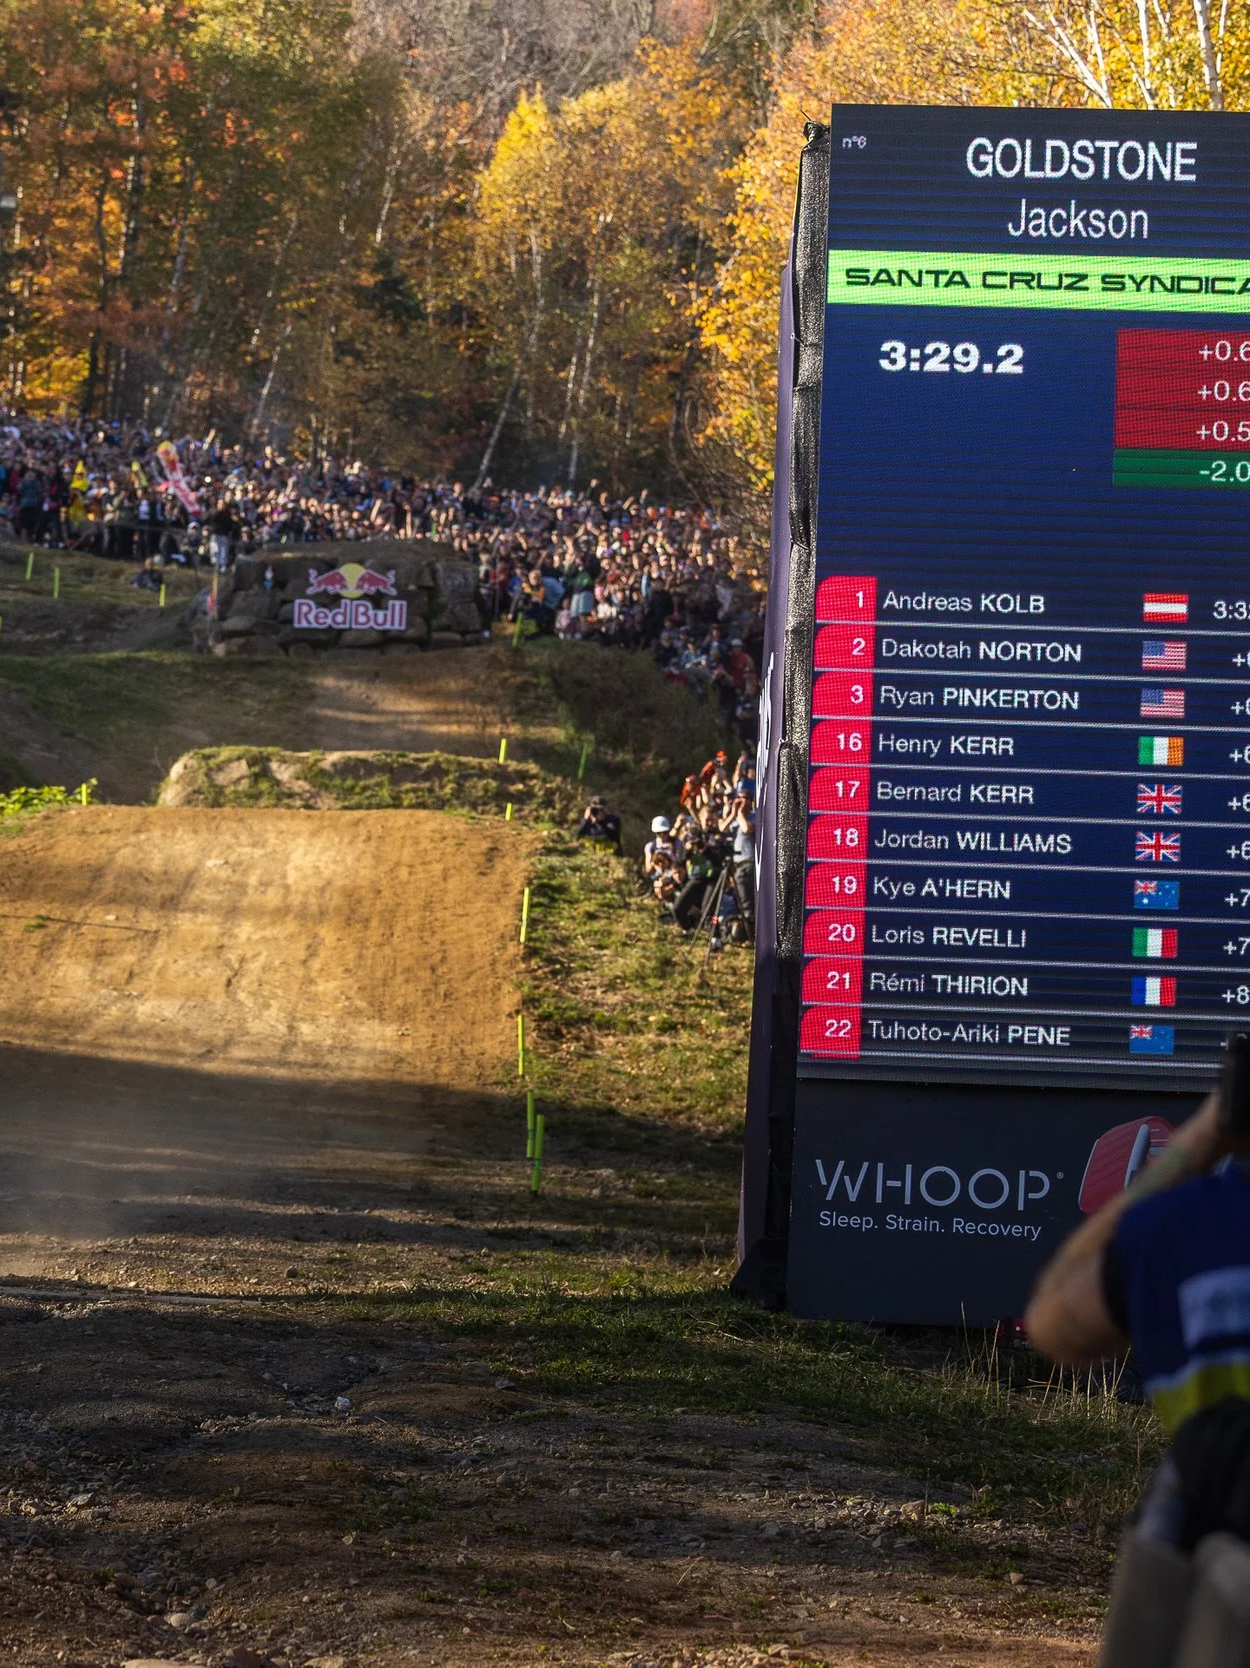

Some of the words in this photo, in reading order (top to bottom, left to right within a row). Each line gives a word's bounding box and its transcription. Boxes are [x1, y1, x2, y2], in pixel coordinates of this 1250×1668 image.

[966, 137, 1198, 182] GOLDSTONE
[1007, 199, 1149, 239] Jackson
[845, 267, 971, 288] SANTA
[981, 272, 1090, 292] CRUZ
[878, 340, 1024, 374] 3:29.2
[855, 592, 865, 608] 1
[882, 591, 973, 611] Andreas
[980, 593, 1046, 613] KOLB
[1213, 600, 1250, 619] 3:3
[852, 639, 866, 657] 2
[881, 639, 972, 659] Dakotah
[979, 641, 1082, 663] NORTON
[850, 685, 864, 704] 3
[879, 686, 934, 708] Ryan
[943, 687, 1079, 711] PINKERTON
[837, 732, 863, 752] 16
[878, 733, 942, 757] Henry
[950, 736, 1014, 756] KERR
[835, 780, 861, 799] 17
[876, 781, 962, 802] Bernard
[969, 784, 1034, 804] KERR
[833, 828, 859, 847] 18
[874, 829, 949, 850] Jordan
[957, 832, 1072, 854] WILLIAMS
[831, 876, 858, 894] 19
[873, 877, 916, 899] Kye
[921, 879, 1011, 900] A'HERN
[828, 924, 856, 942] 20
[871, 925, 926, 946] Loris
[932, 927, 1027, 948] REVELLI
[826, 971, 851, 990] 21
[869, 972, 925, 993] Rémi
[931, 974, 1029, 996] THIRION
[824, 1019, 852, 1038] 22
[867, 1020, 1000, 1042] Tuhoto-Ariki
[1008, 1025, 1071, 1047] PENE
[819, 1211, 878, 1231] Sleep.
[886, 1214, 945, 1233] Strain.
[952, 1217, 1042, 1241] Recovery
